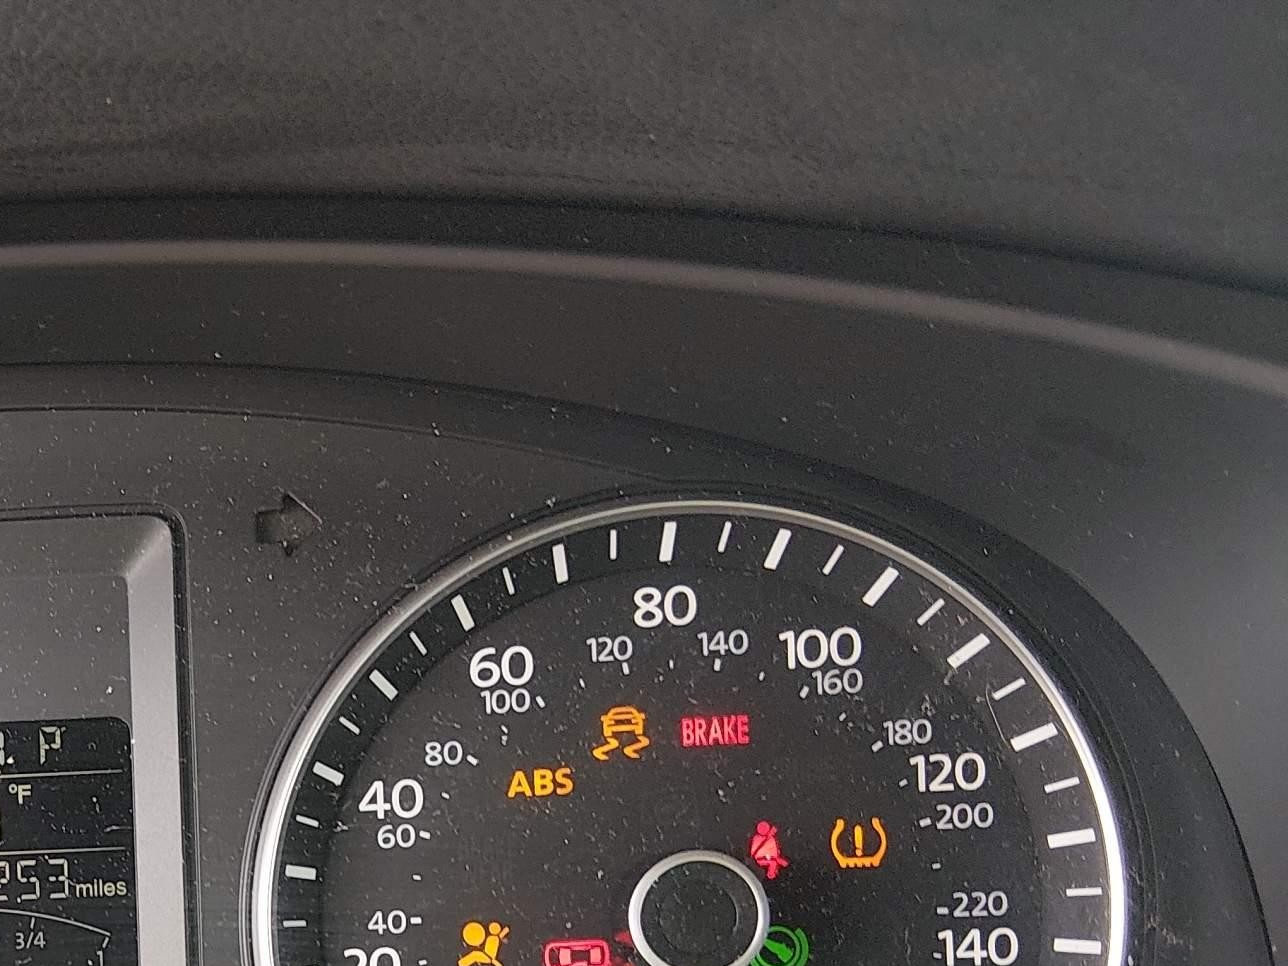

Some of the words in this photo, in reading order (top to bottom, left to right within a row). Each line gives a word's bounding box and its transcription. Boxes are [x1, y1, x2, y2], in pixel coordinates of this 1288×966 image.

[632, 584, 697, 628] 80
[586, 635, 633, 662] 120
[697, 629, 749, 657] 140
[778, 626, 862, 669] 100
[469, 645, 534, 688] 60
[812, 669, 864, 696] 160
[480, 688, 531, 714] 100
[681, 714, 750, 747] BRAKE
[882, 718, 932, 745] 180
[424, 740, 463, 767] 80
[507, 767, 574, 799] ABS
[909, 752, 986, 793] 120
[358, 778, 424, 820] 40
[936, 802, 994, 830] 200
[377, 823, 416, 849] 60
[75, 879, 127, 899] miles
[952, 891, 1009, 919] 220
[367, 910, 408, 934] 40
[15, 931, 46, 950] 3/4
[937, 928, 1018, 966] 140
